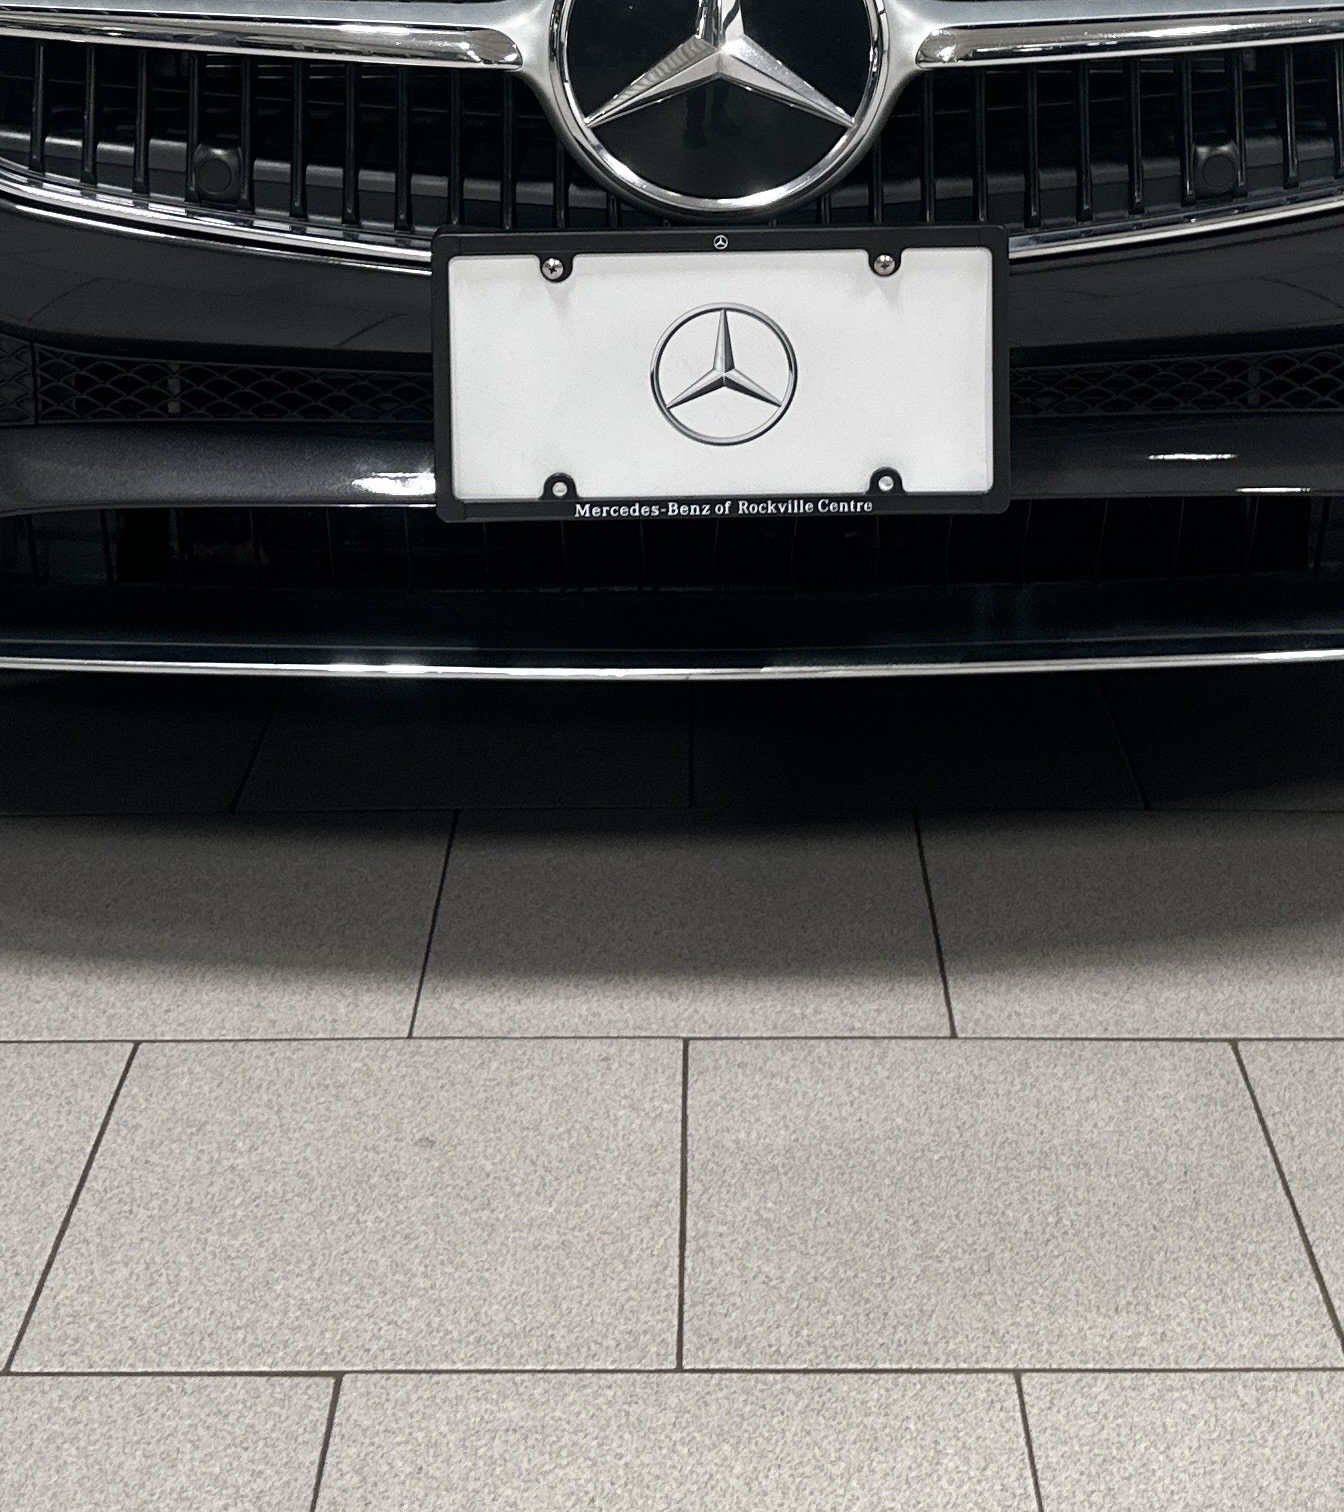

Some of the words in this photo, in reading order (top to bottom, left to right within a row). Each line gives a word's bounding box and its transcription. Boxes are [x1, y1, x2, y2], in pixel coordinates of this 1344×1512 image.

[574, 500, 710, 518] Mercedes-Benz
[715, 500, 732, 515] of
[738, 499, 814, 514] Rockville
[817, 498, 873, 513] Centre
